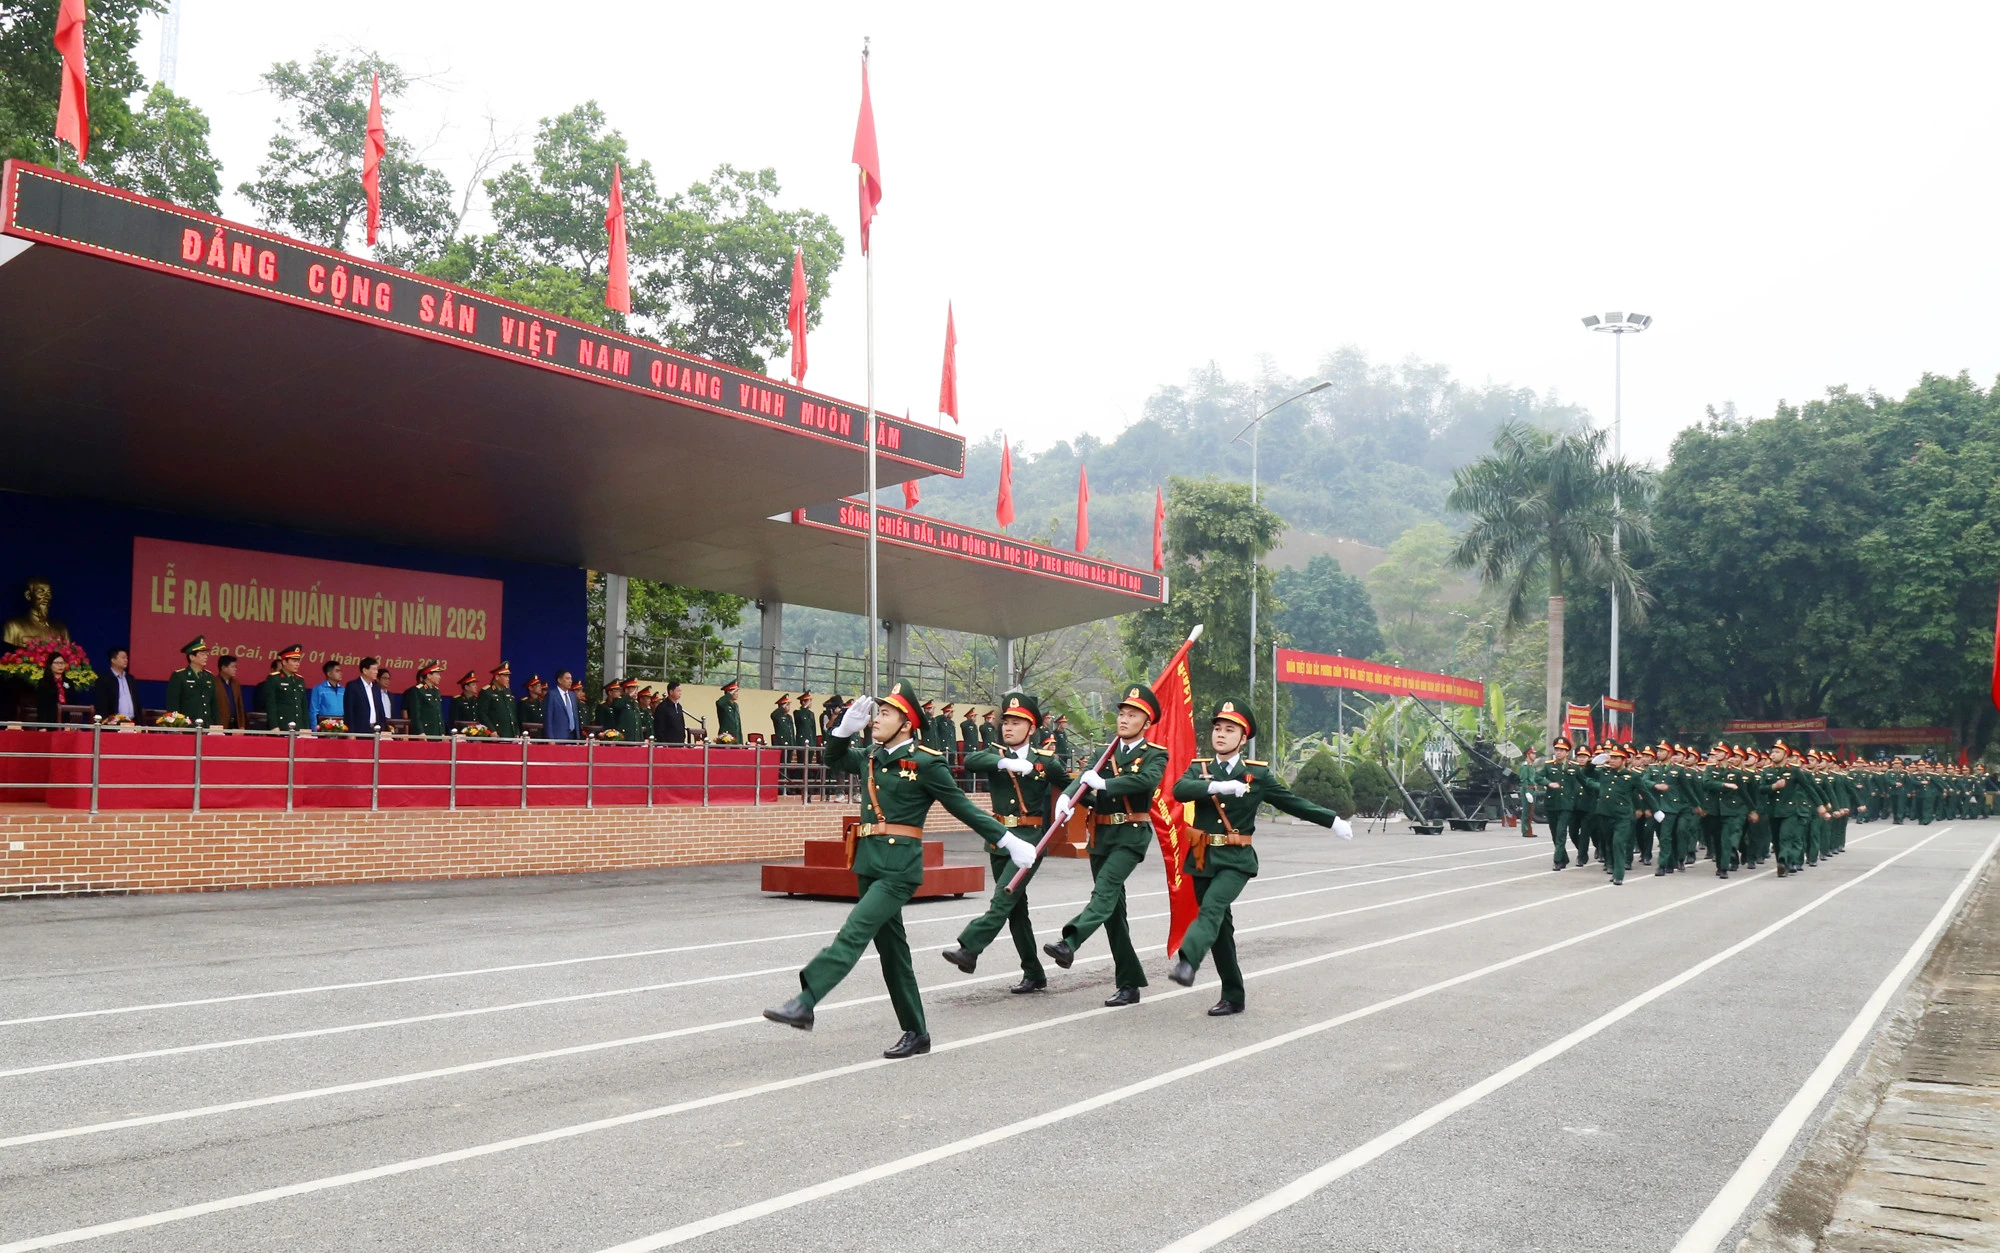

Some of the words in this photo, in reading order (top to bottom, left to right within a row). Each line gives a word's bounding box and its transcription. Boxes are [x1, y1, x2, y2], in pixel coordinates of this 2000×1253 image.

[182, 227, 278, 282] ĐẢNG
[308, 263, 392, 312] CỘNG
[419, 292, 477, 334] SẢN
[501, 316, 558, 357] VIỆT
[578, 338, 631, 376] NAM
[651, 359, 721, 401] QUANG
[740, 383, 785, 418] VINH
[800, 401, 851, 437] MUÔN
[840, 504, 870, 530] SỐNG
[878, 516, 910, 539] CHIẾN
[913, 522, 937, 546] ĐẤU,
[940, 530, 959, 549] LAO
[962, 534, 987, 555] ĐỘNG
[990, 541, 1001, 559] VÀ
[1004, 545, 1020, 566] HỌC
[1023, 549, 1039, 569] TẬP
[1042, 555, 1061, 573] THEO
[1064, 560, 1089, 579] GƯƠNG
[1091, 565, 1106, 582] BÁC
[1119, 572, 1128, 587] VĨ
[1129, 577, 1143, 592] ĐẠI
[151, 562, 176, 614] LỄ
[183, 578, 211, 617] RA
[218, 578, 275, 623] QUÂN
[280, 580, 334, 628] HUẤN
[339, 592, 396, 640] LUYỆN
[401, 596, 442, 637] NĂM
[446, 606, 486, 641] 2023
[207, 642, 230, 656] ào
[235, 644, 263, 661] Cai,
[309, 650, 326, 664] 01
